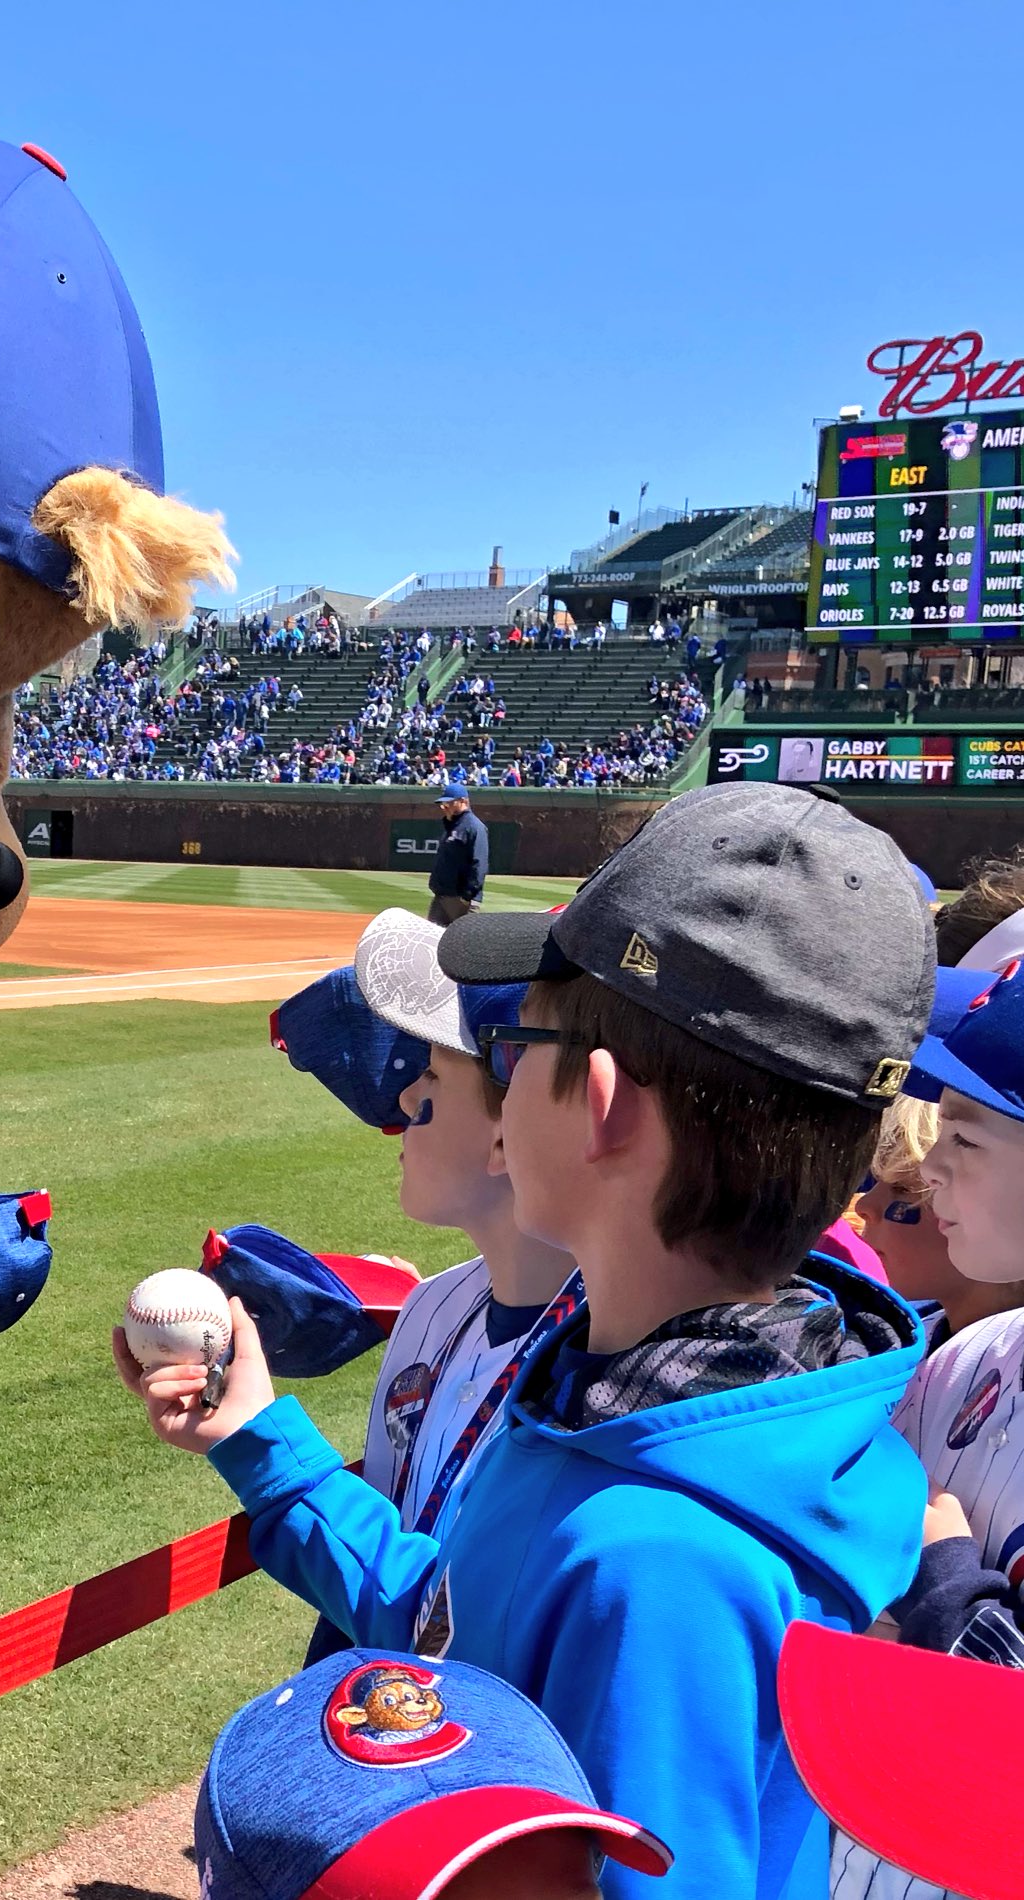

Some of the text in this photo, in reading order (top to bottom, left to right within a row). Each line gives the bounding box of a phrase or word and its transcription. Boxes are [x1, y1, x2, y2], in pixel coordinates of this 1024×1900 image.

[866, 330, 1024, 417] Bu
[890, 466, 927, 486] EAST
[831, 505, 875, 520] RED SOX
[902, 503, 926, 516] 19-7
[828, 532, 875, 545] YANKEES
[899, 529, 923, 542] 17-9
[938, 526, 975, 541] 2.0 GB
[825, 556, 880, 571] BLUE JAYS
[893, 555, 923, 569] 14-12
[935, 552, 972, 566] 5.0 GB
[822, 583, 849, 597] RAYS
[889, 580, 920, 594] 12-13
[932, 578, 968, 593] 6.5 GB
[986, 577, 1023, 591] WHITE
[820, 609, 864, 622] ORIOLES
[889, 607, 914, 620] 7-20
[923, 605, 965, 619] 12.5 GB
[827, 740, 886, 755] GABBY
[969, 741, 1001, 752] CUBS
[825, 760, 954, 780] HARTNETT
[966, 768, 1014, 780] CAREER
[28, 822, 52, 839] A
[182, 841, 202, 855] 368
[522, 1330, 548, 1360] Tropicana
